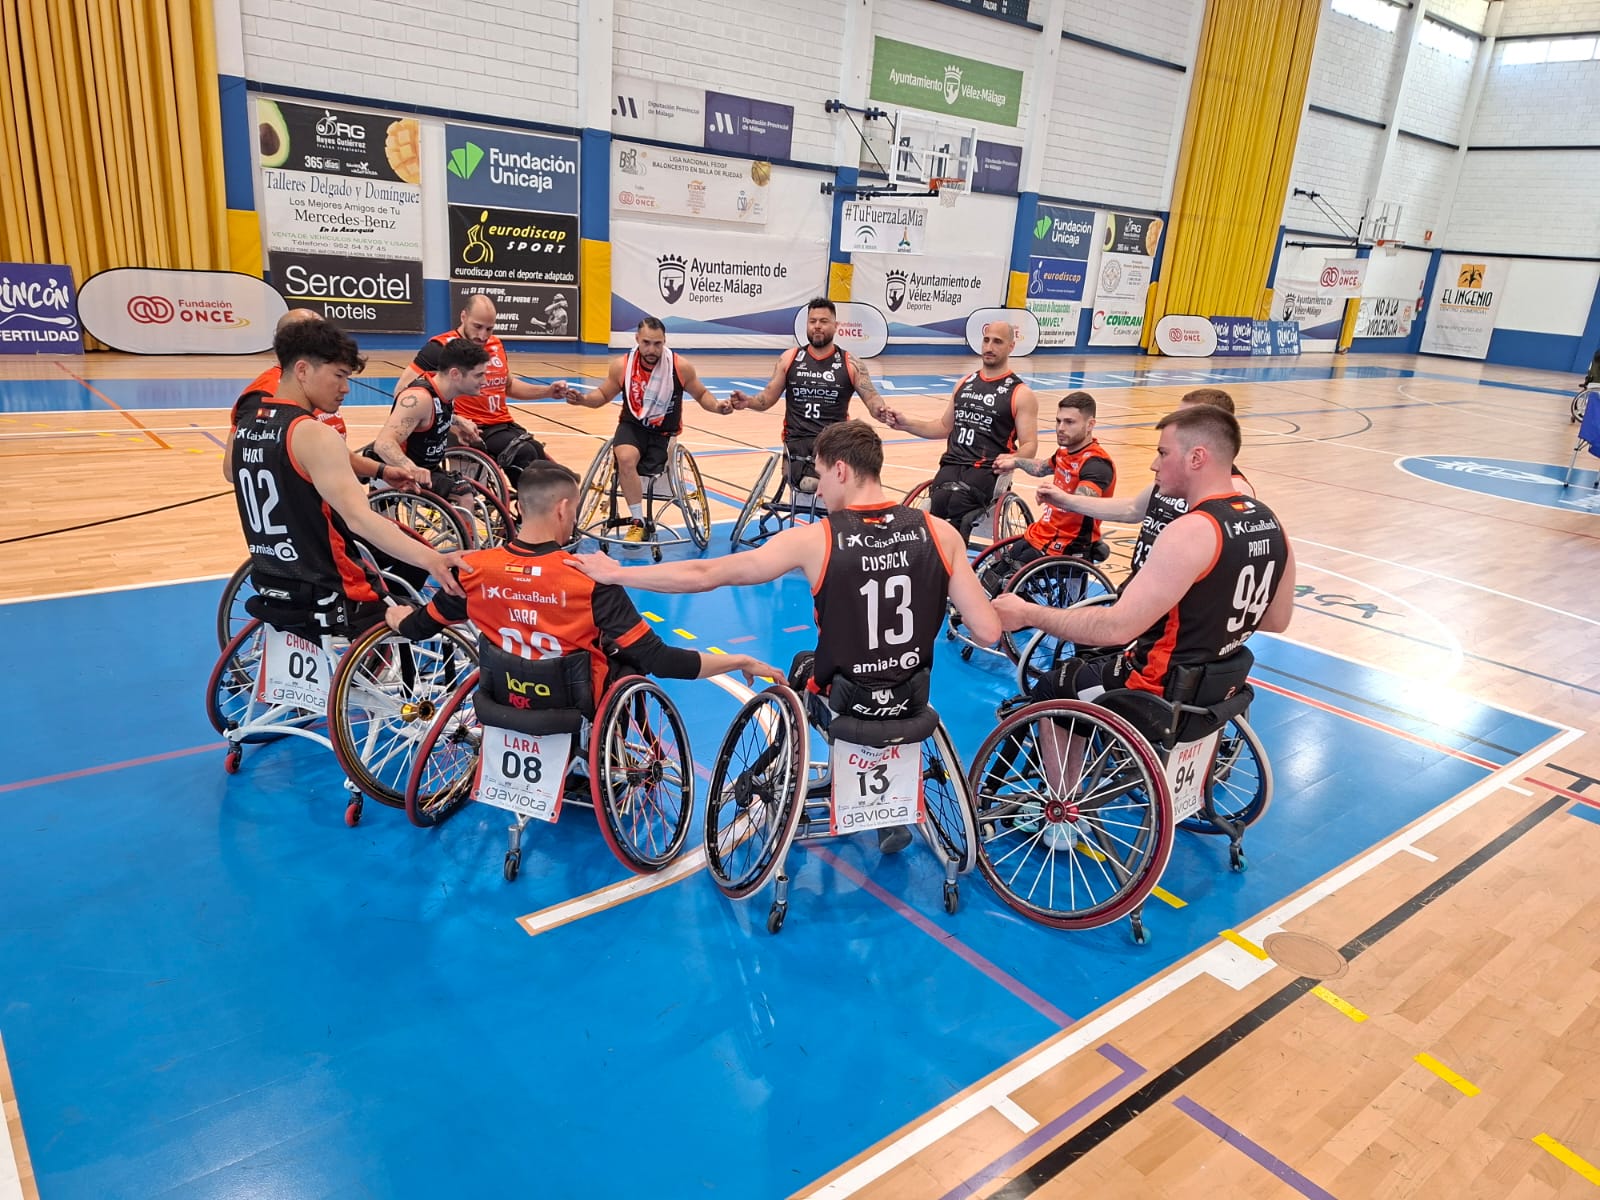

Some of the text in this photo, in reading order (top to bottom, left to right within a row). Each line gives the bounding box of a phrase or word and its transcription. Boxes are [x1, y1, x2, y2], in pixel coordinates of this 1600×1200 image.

[890, 68, 942, 91] Ayuntamiento
[961, 84, 1006, 106] Vélez-Málaga
[337, 123, 366, 139] RG
[304, 155, 323, 169] 365
[489, 147, 576, 174] Fundación
[652, 161, 689, 172] BALONCESTO
[698, 166, 713, 175] SILLA
[722, 170, 743, 178] RUEDAS
[683, 157, 710, 167] NACIONAL
[264, 171, 420, 205] Talleres Delgado y Domínguez
[490, 166, 553, 193] Unicaja
[289, 197, 401, 215] Los Mejores Amigos de Tu
[635, 199, 655, 207] ONCE
[294, 209, 396, 230] Mercedes-Benz
[1053, 218, 1092, 235] Fundación
[271, 231, 296, 239] VENTA
[488, 224, 567, 243] eurodiscap
[1051, 231, 1080, 248] Unicaja
[506, 241, 566, 254] SPORT
[454, 267, 575, 283] eurodiscap con el deporte adaptado
[690, 258, 787, 279] Ayuntamiento de
[1043, 272, 1081, 284] eurodiscap
[285, 264, 411, 300] Sercotel
[690, 276, 763, 297] Vélez-Málaga
[909, 272, 982, 289] Ayuntamiento de
[1339, 276, 1358, 286] ONCE
[178, 299, 233, 309] Fundación
[689, 292, 724, 303] Deportes
[906, 301, 932, 311] Deportes
[909, 288, 962, 306] Vélez-Málaga
[1441, 288, 1494, 307] EL INGENIO
[180, 310, 235, 323] ONCE
[323, 302, 377, 321] hotels
[495, 312, 520, 321] AMIVEL
[1374, 298, 1386, 316] NO
[0, 330, 80, 342] ERTILIDAD
[838, 329, 863, 337] ONCE
[796, 370, 823, 379] amiab
[792, 387, 839, 398] gaviota
[804, 402, 821, 419] 25
[238, 467, 289, 535] 02
[1244, 519, 1277, 533] CaixaBank
[864, 529, 919, 548] CaixaBank
[1248, 538, 1270, 558] PRATT
[861, 550, 910, 572] CUSACK
[501, 587, 559, 605] CaixaBank
[1226, 560, 1276, 633] 94
[508, 607, 538, 625] LARA
[859, 574, 914, 650] 13
[286, 633, 319, 656] CHUKAI
[288, 651, 319, 684] 02
[852, 656, 898, 675] amiab
[505, 671, 551, 697] lara
[273, 688, 326, 708] gaviota
[504, 734, 541, 754] LARA
[1178, 742, 1203, 763] PRATT
[501, 751, 542, 783] 08
[856, 763, 890, 797] 13
[1174, 761, 1195, 794] 94
[485, 785, 547, 812] gaviota
[843, 806, 909, 828] gaviota
